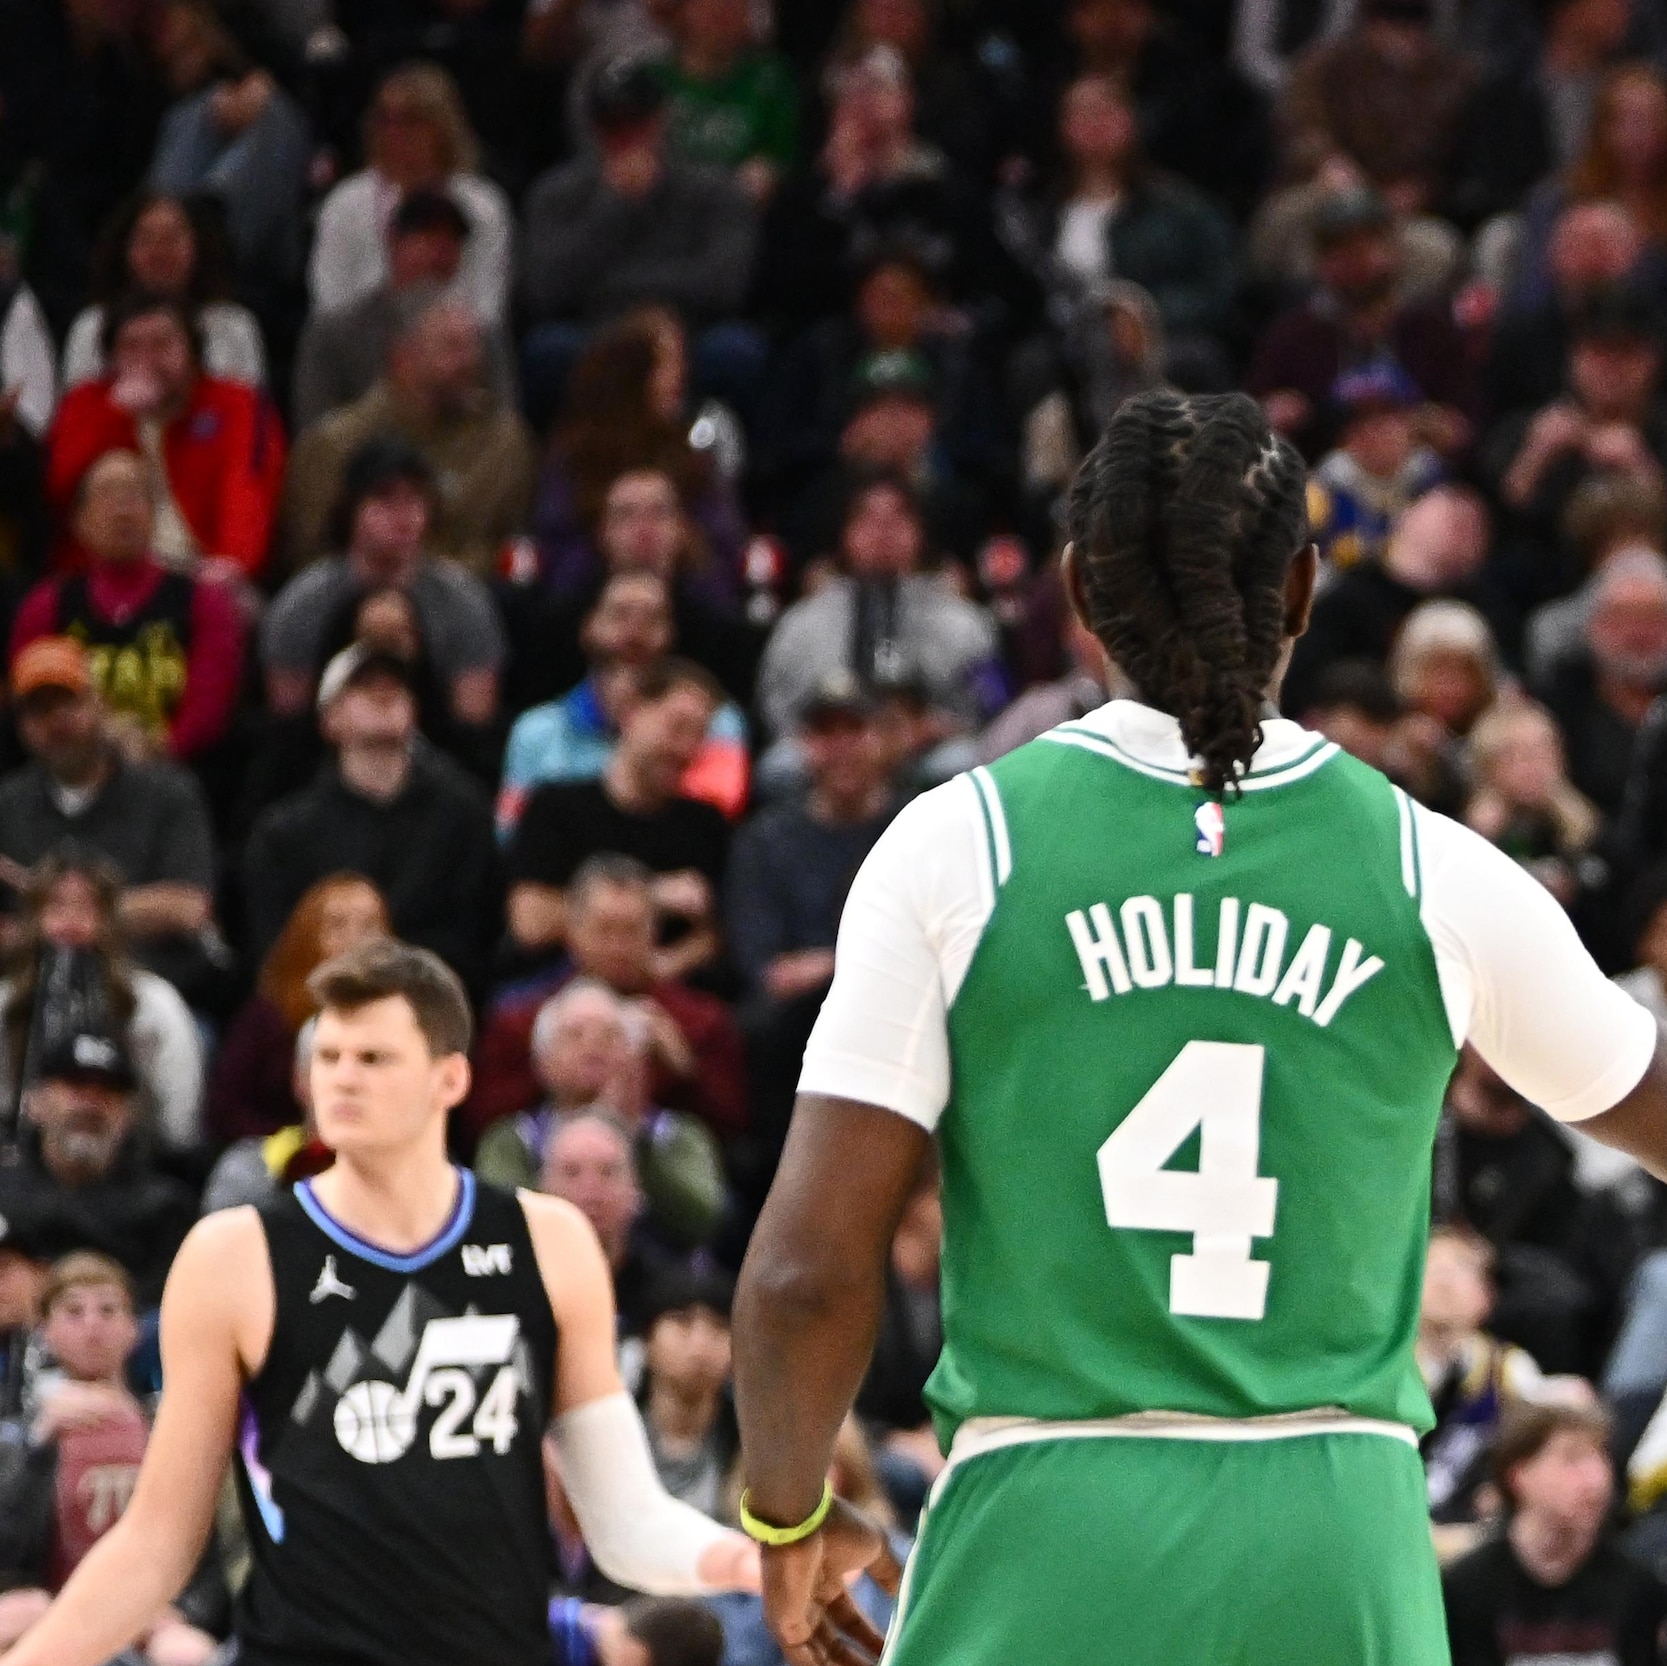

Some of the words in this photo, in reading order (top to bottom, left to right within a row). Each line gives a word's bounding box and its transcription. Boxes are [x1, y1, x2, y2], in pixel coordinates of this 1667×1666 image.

[1063, 893, 1386, 1028] HOLIDAY
[1095, 1040, 1278, 1321] 4
[424, 1365, 520, 1461] 24
